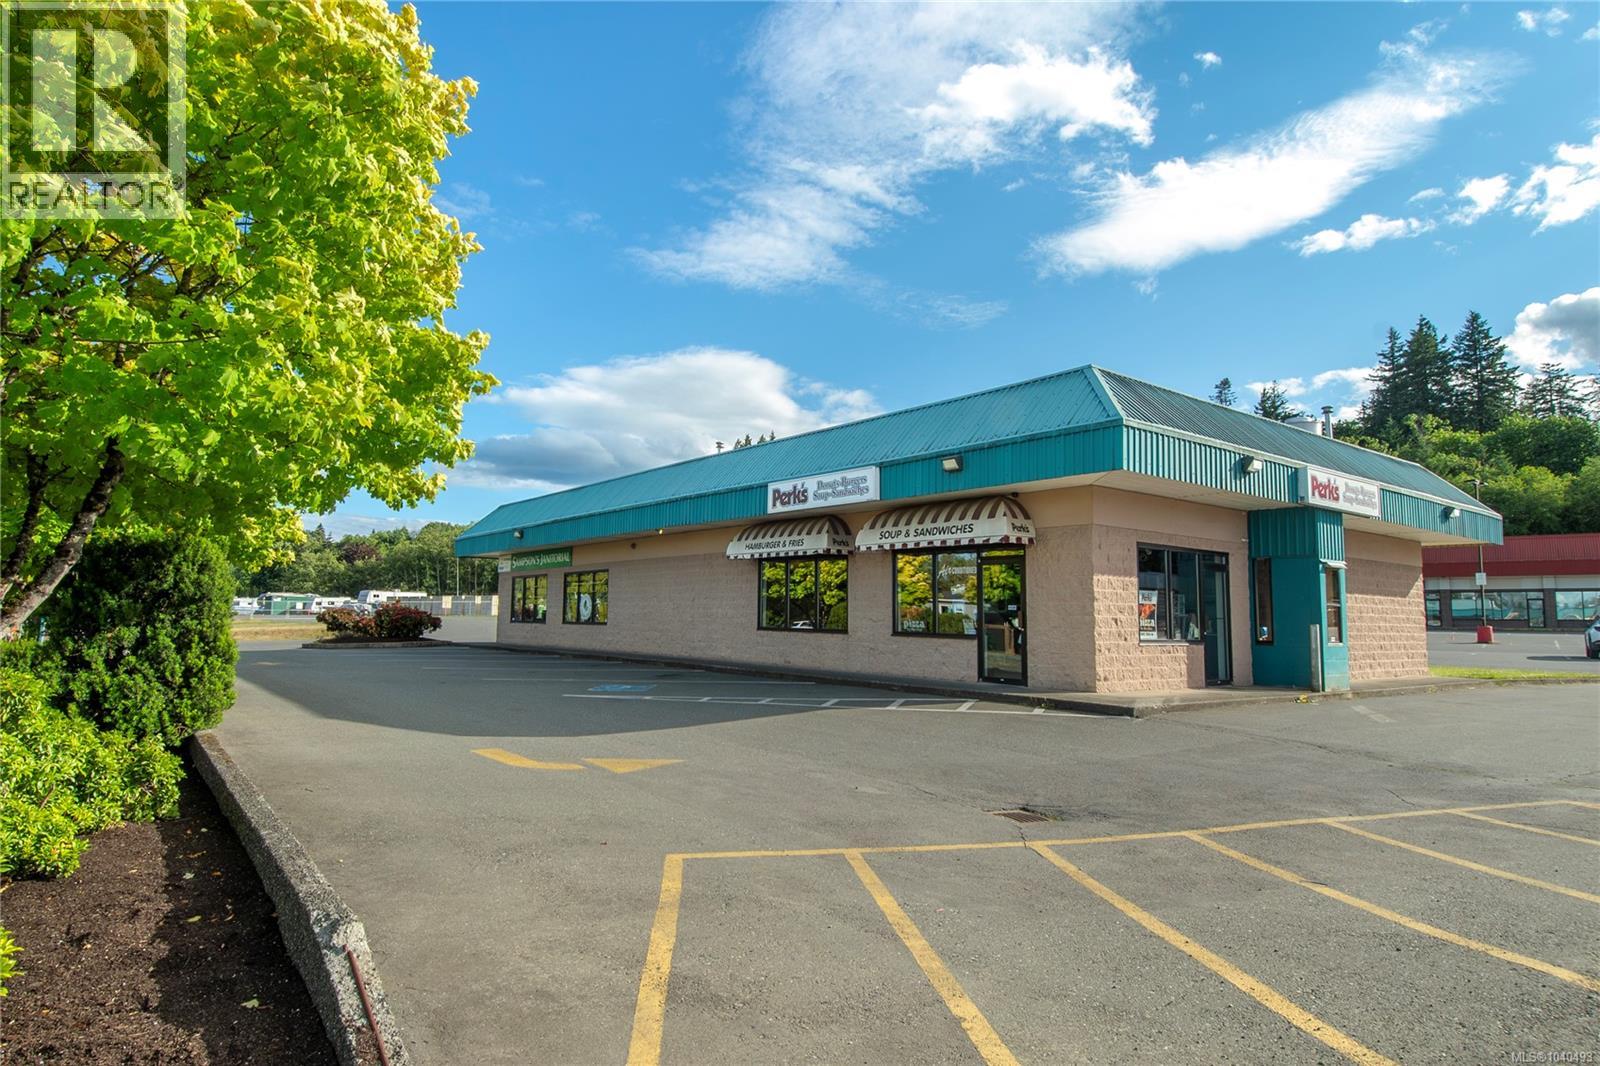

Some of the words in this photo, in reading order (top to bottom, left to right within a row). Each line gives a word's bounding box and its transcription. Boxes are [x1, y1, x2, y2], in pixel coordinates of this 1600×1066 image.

[772, 482, 808, 509] Perk's
[1310, 474, 1340, 502] Perk's
[879, 529, 902, 540] SOUP
[904, 529, 910, 538] &
[913, 523, 974, 538] SANDWICHES
[745, 541, 781, 550] HAMBURGER
[782, 540, 787, 548] &
[788, 539, 804, 547] FRIES
